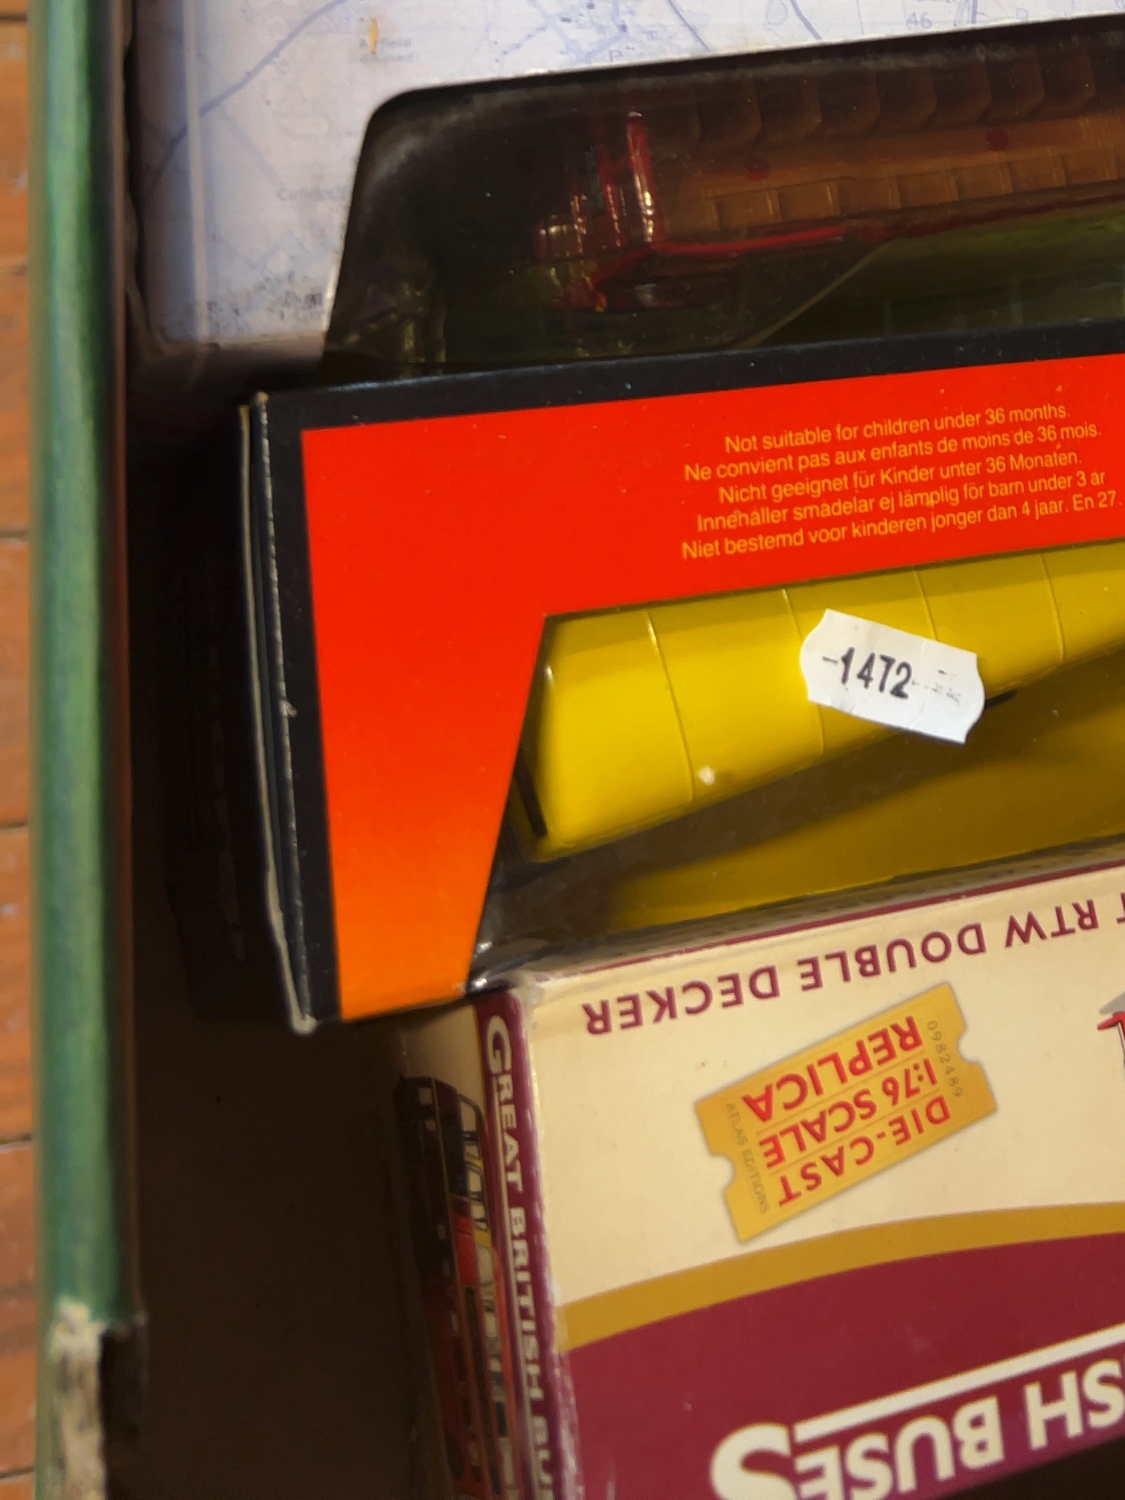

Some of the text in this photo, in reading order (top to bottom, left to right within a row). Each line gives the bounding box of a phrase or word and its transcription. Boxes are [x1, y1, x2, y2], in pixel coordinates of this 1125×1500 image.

[684, 420, 1102, 481] Ne convient pas aux enfants de moins de 36 mois.
[725, 403, 1071, 453] Not suitable for children under 36 months.
[718, 451, 1083, 504] Nicht geeignet für Kinder unter 36 Monaten.
[879, 494, 895, 514] ej
[898, 486, 960, 510] lämplig
[963, 480, 984, 500] för
[988, 479, 1025, 498] barn
[1028, 474, 1073, 494] under
[1076, 470, 1087, 487] 3
[681, 489, 1123, 560] Niet bestemd voor kinderen jonger dan 4 jaar. En 27.
[797, 922, 987, 992] DOUBLE
[1004, 897, 1099, 948] RTW
[581, 965, 780, 1037] DECKER
[741, 1015, 924, 1124] REPLICA
[758, 1057, 938, 1169] 1:76 SCALE
[726, 1102, 771, 1214] ATLAS EDITIONS
[778, 1094, 951, 1208] DIE-CAST
[486, 1014, 524, 1194] GREAT
[510, 1206, 546, 1402] BRITISH
[708, 1396, 1004, 1500] BUSES
